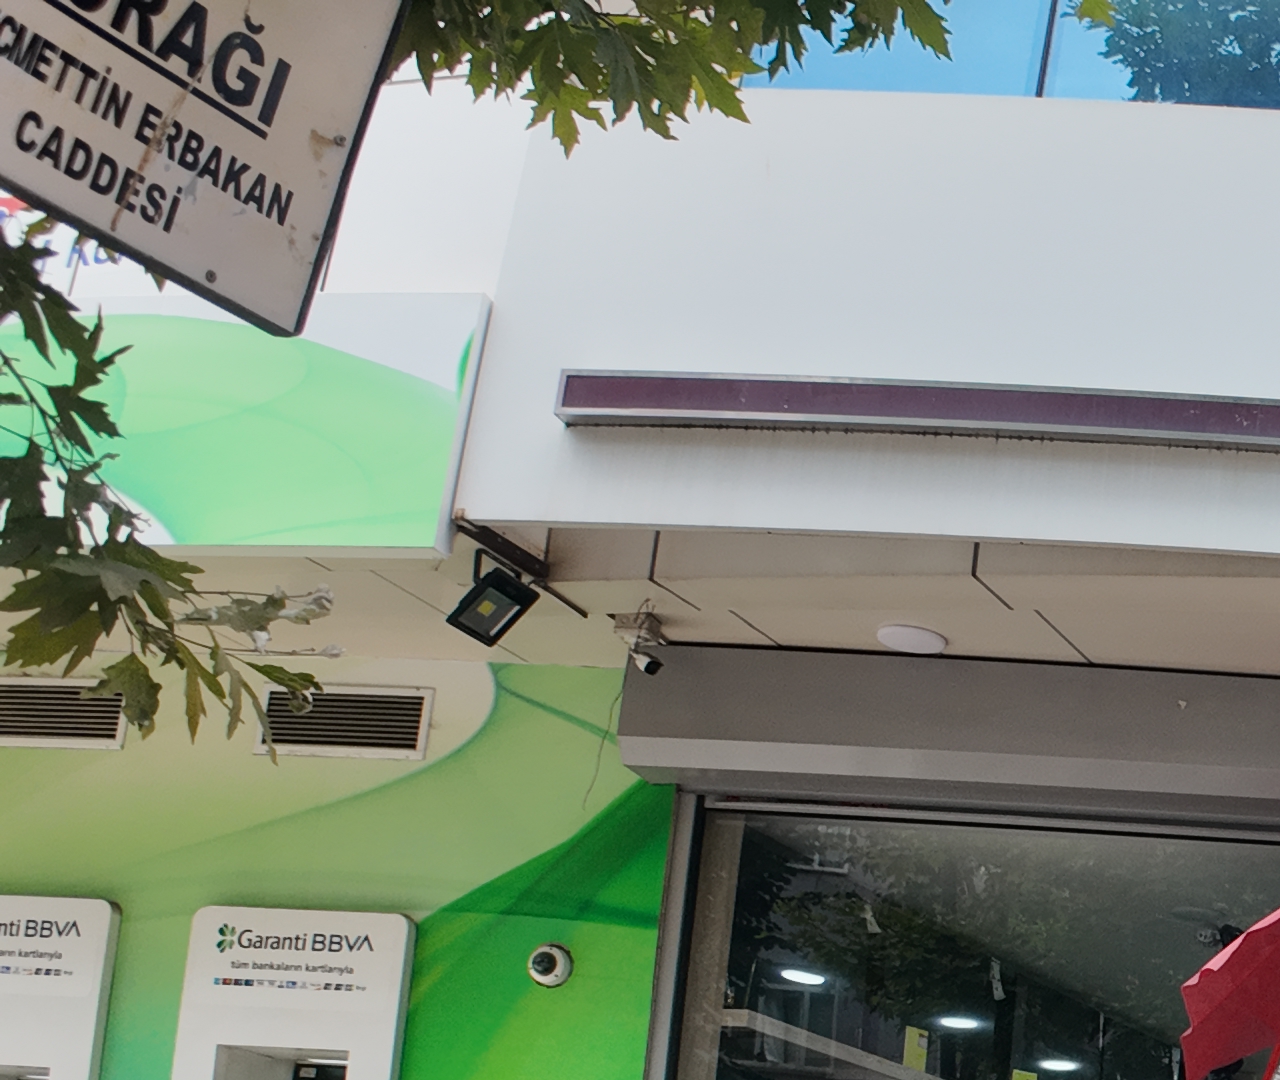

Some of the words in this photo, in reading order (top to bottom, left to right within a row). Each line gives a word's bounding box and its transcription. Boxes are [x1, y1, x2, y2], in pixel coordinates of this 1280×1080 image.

[68, 0, 292, 128] RAĞI
[15, 111, 183, 233] CADDESİ
[135, 103, 293, 226] ERBAKAN
[25, 920, 81, 938] BBVA
[237, 930, 308, 951] Garanti
[312, 934, 374, 952] BBVA
